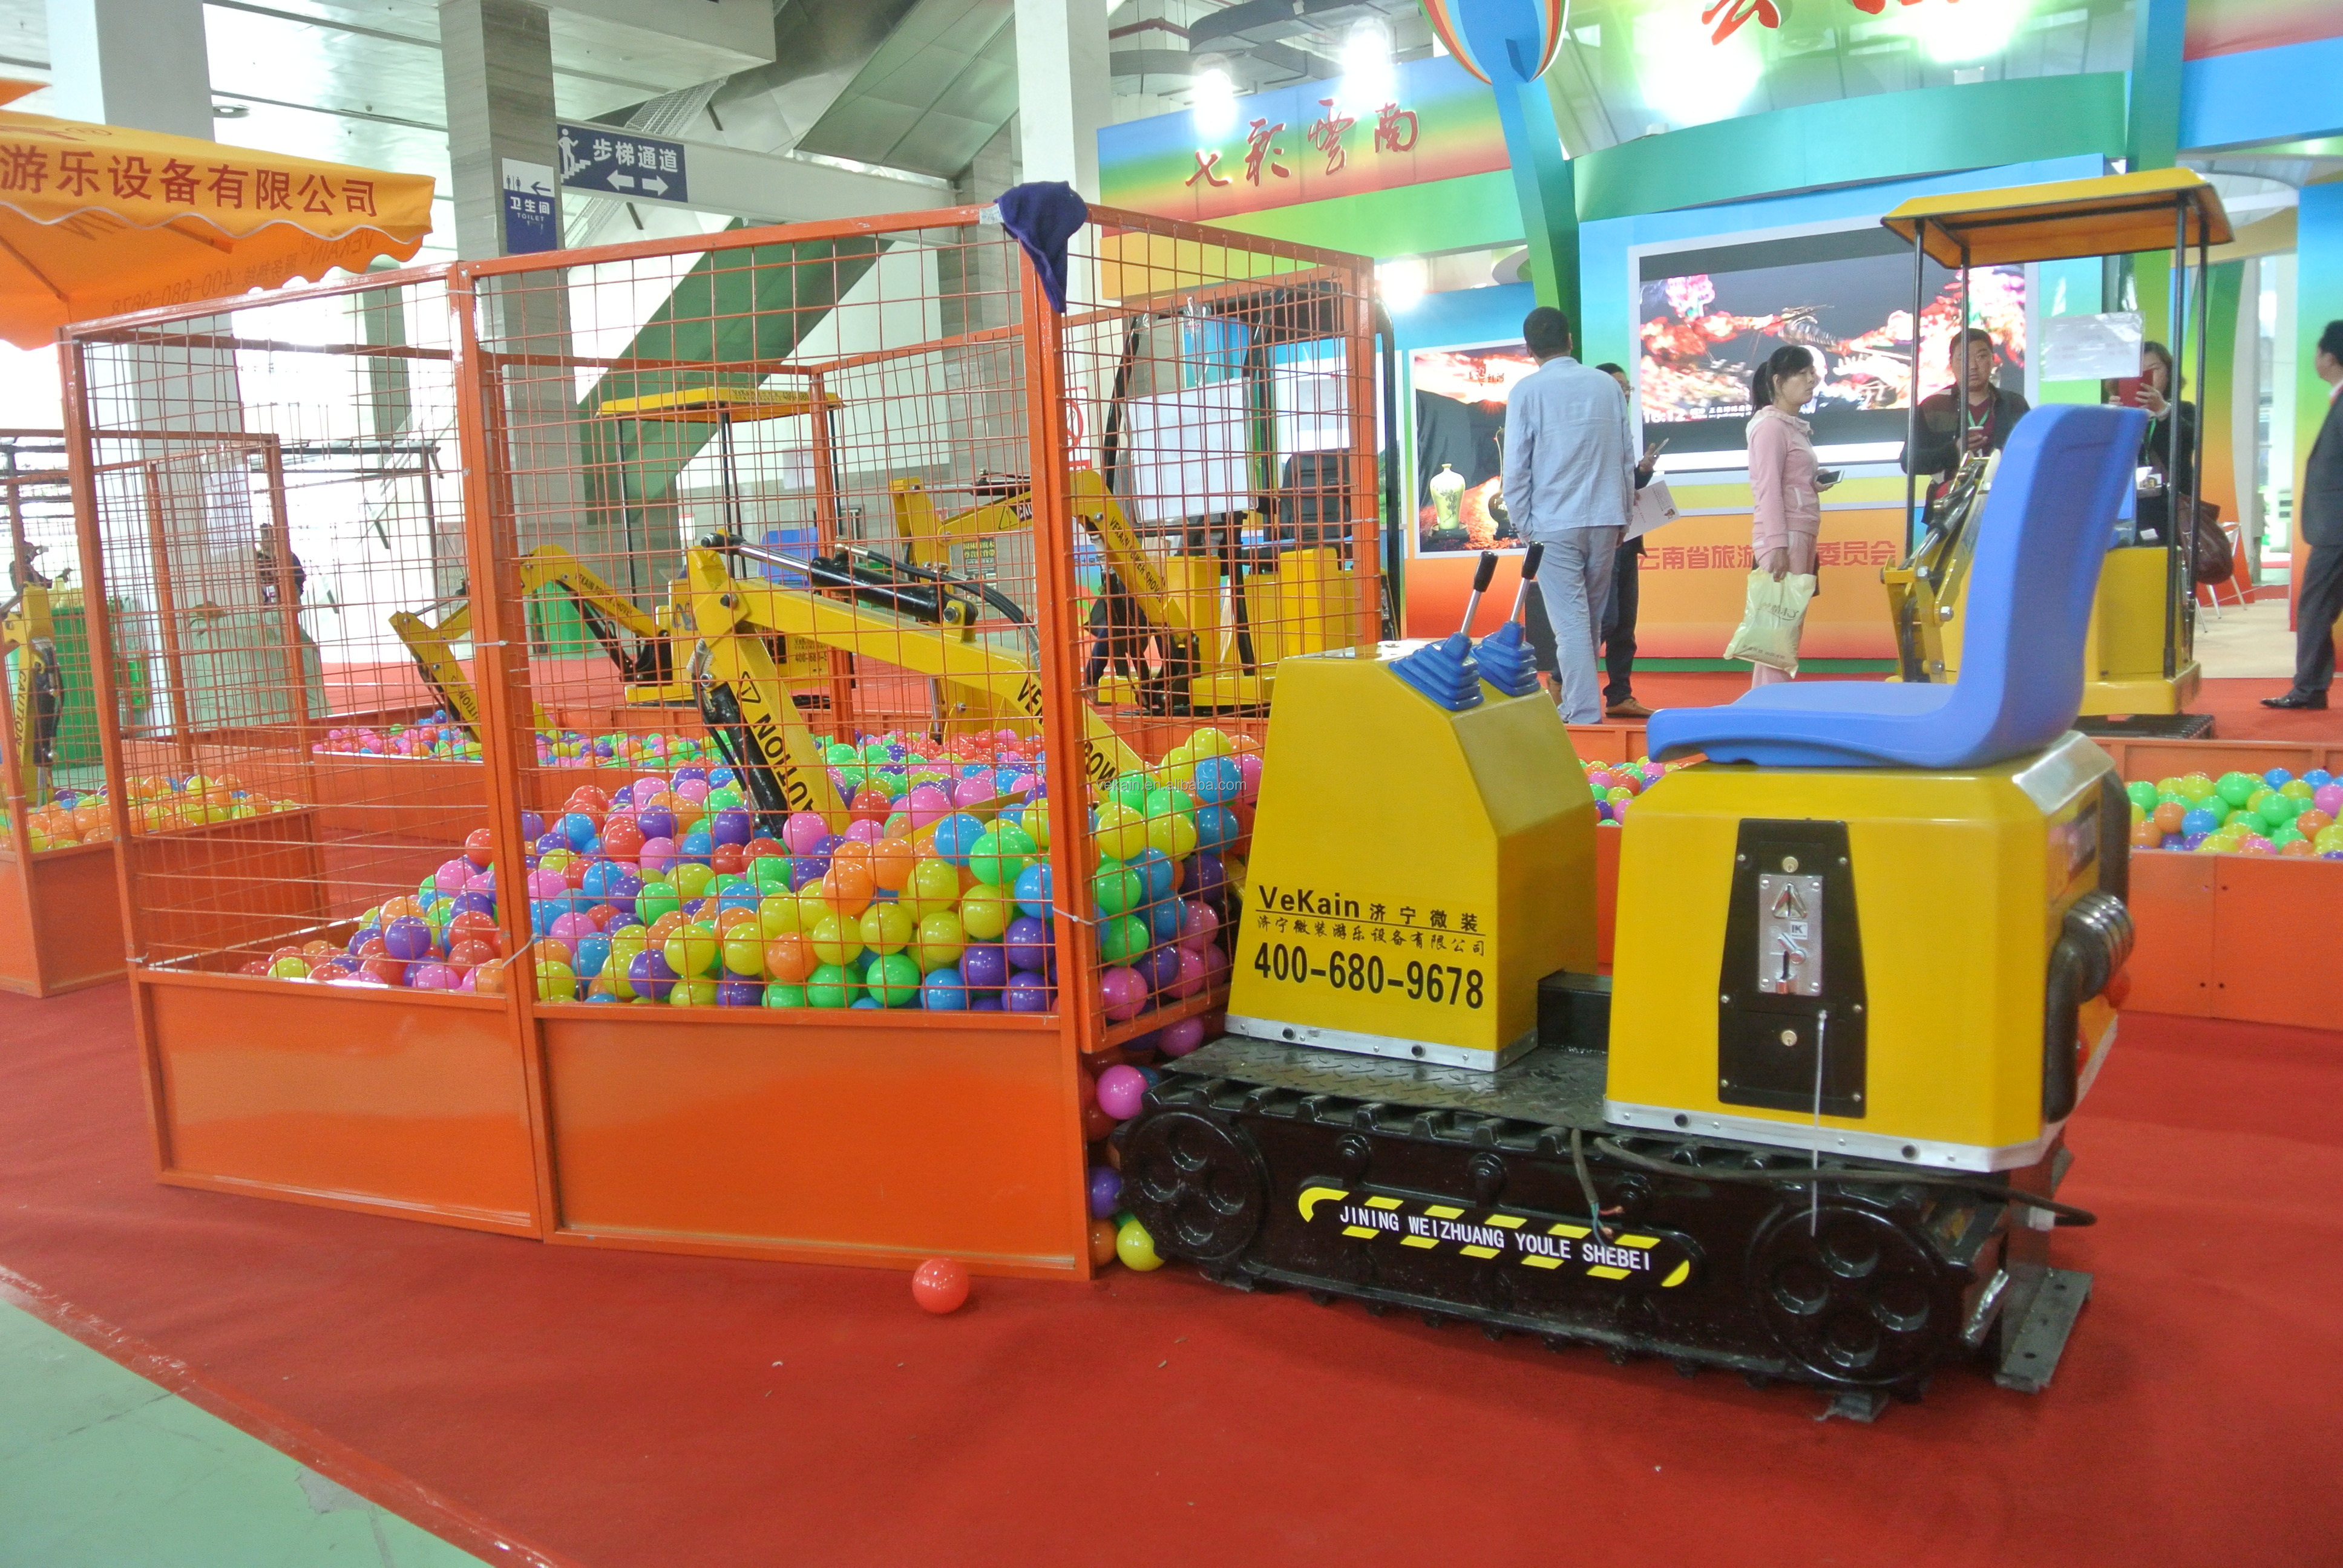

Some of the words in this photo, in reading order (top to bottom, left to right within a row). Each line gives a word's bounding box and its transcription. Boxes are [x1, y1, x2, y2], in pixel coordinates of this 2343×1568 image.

[592, 138, 678, 174] 步梯通道
[0, 143, 378, 217] 游乐设备有限公司
[510, 196, 550, 215] 卫生间
[517, 212, 544, 221] TOILET
[1637, 540, 1896, 570] 云南省旅游委员会
[1258, 885, 1360, 918] VeKain
[1254, 942, 1484, 1010] 400-680-9678
[1340, 1205, 1399, 1232] JINING
[1408, 1215, 1504, 1249] WEIZHUANG
[1515, 1232, 1571, 1259] YOULE
[1582, 1242, 1650, 1271] SHEBEI
